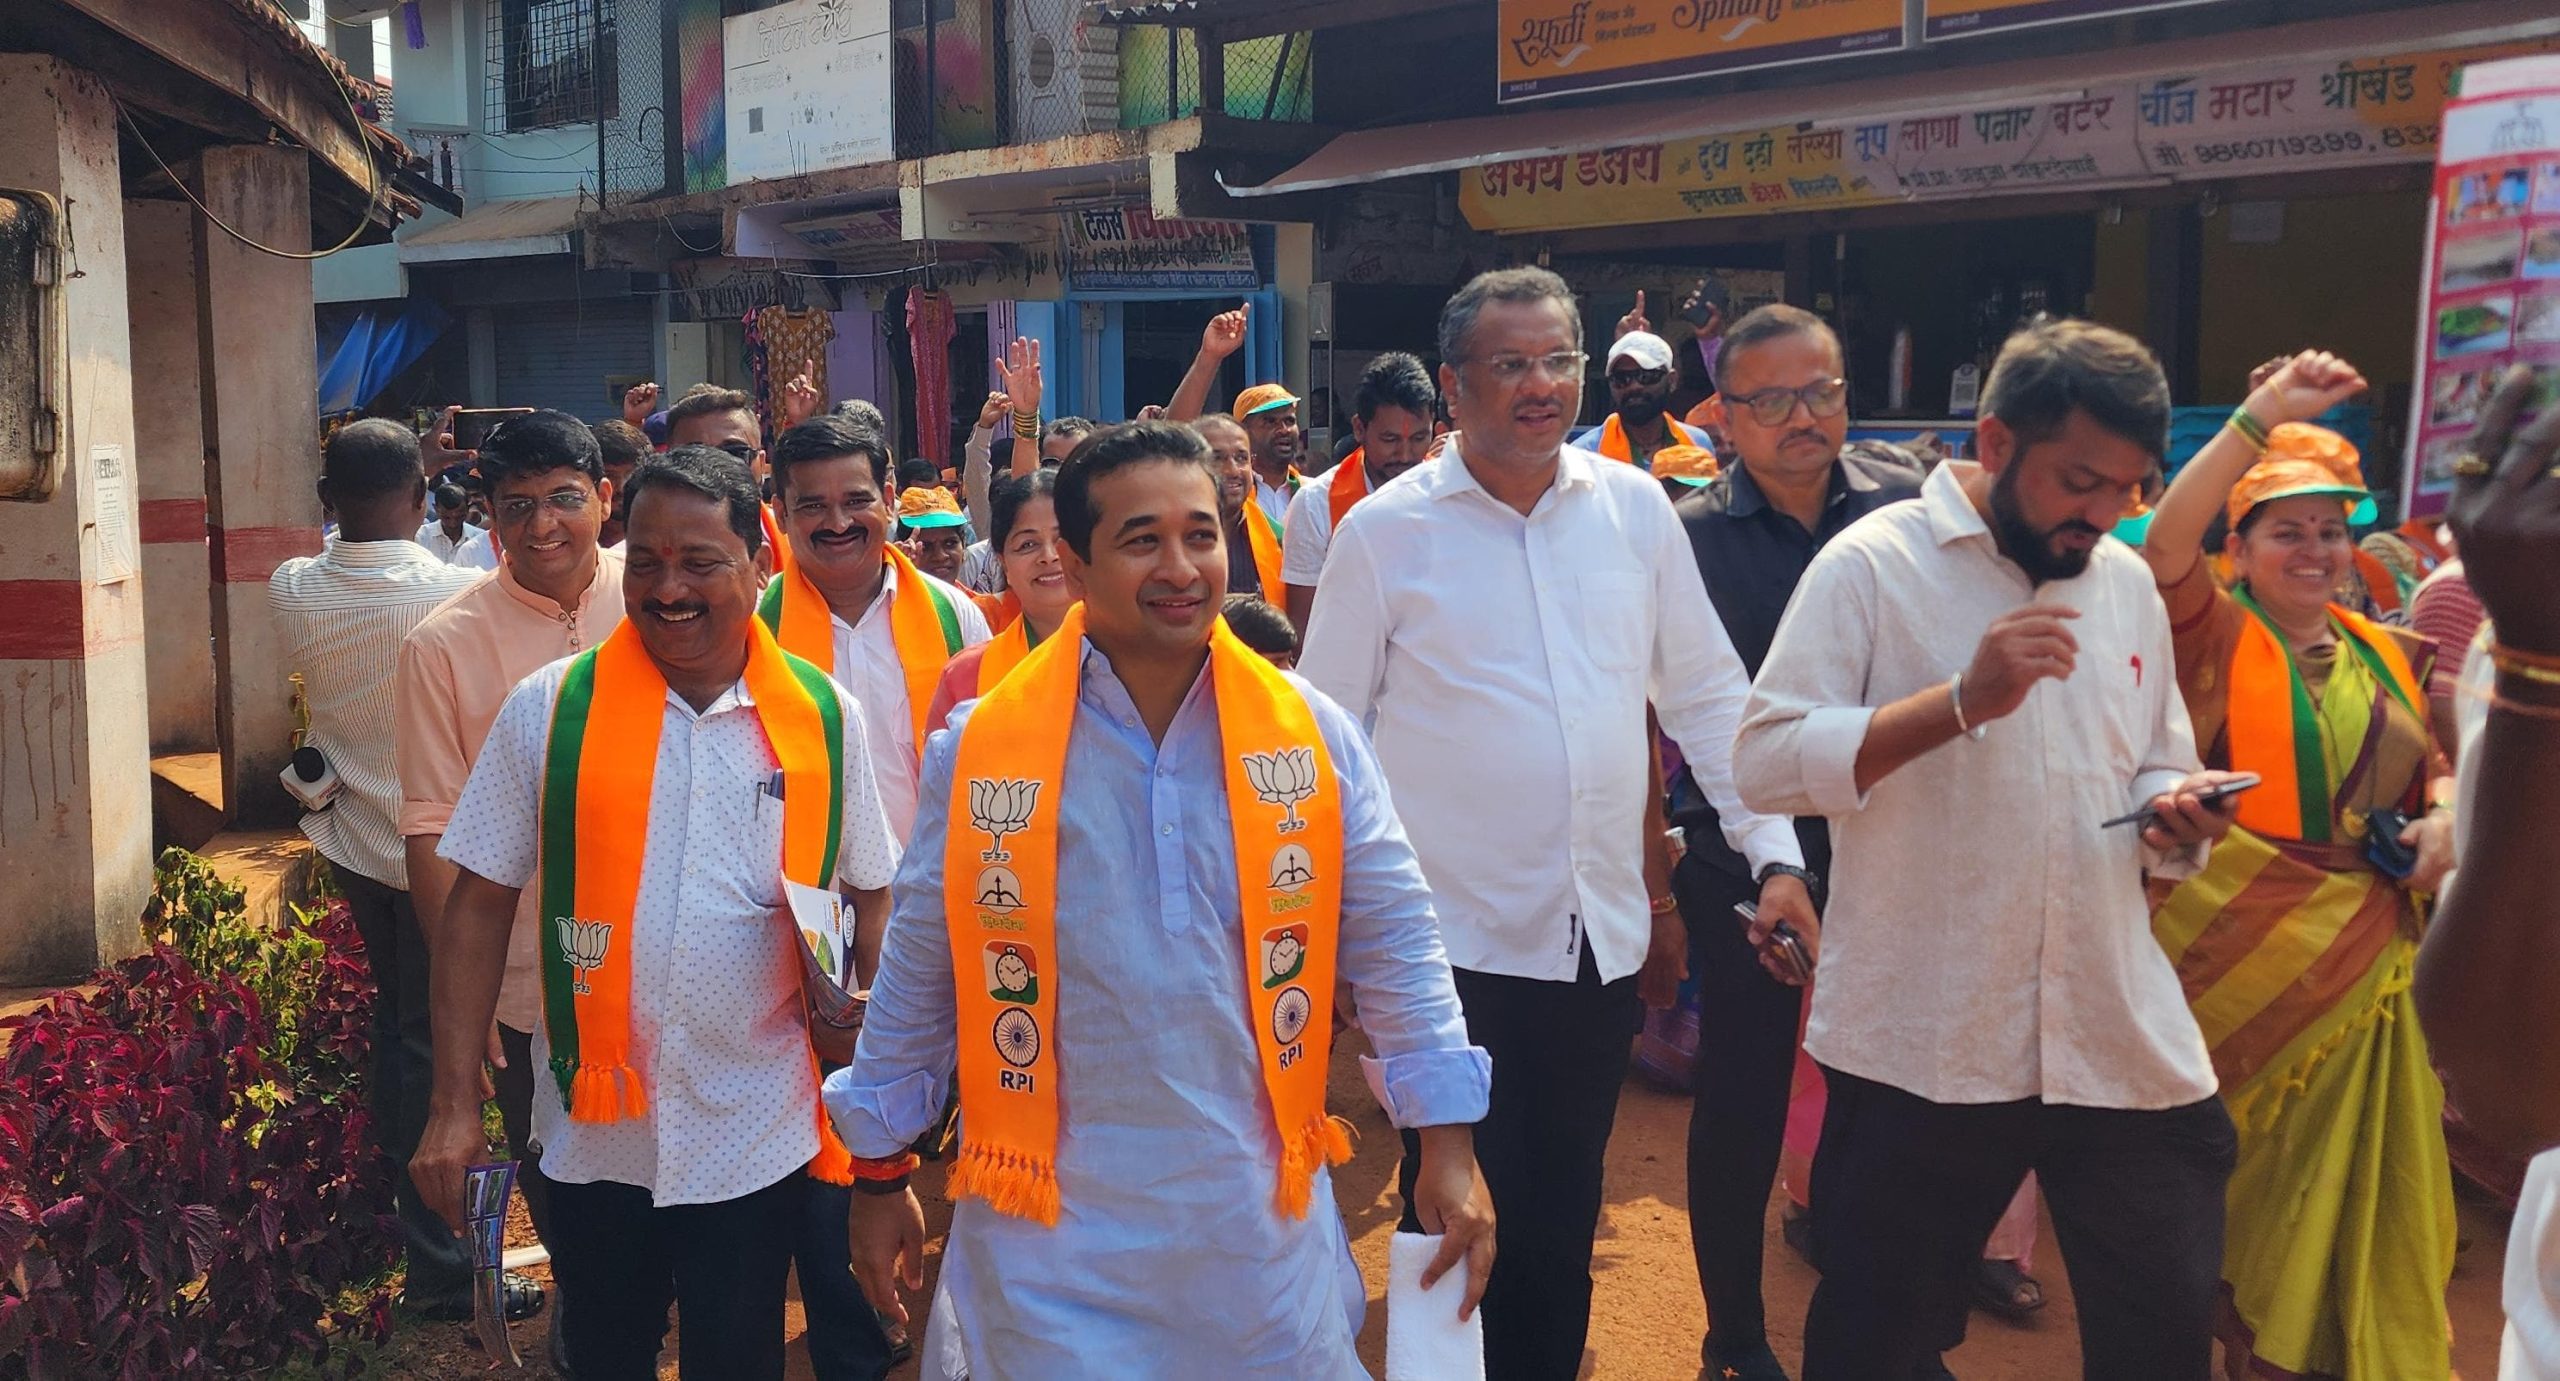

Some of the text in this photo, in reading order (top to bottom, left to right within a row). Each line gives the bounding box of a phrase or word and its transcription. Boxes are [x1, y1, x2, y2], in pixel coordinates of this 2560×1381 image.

[1744, 131, 1775, 173] दही
[1855, 123, 1888, 162] तूप
[2209, 78, 2296, 122] मटार
[2320, 59, 2418, 109] श्रीखंड
[1481, 155, 1567, 197] अभय
[1279, 1042, 1302, 1072] RPI
[1001, 1069, 1034, 1094] RPI
